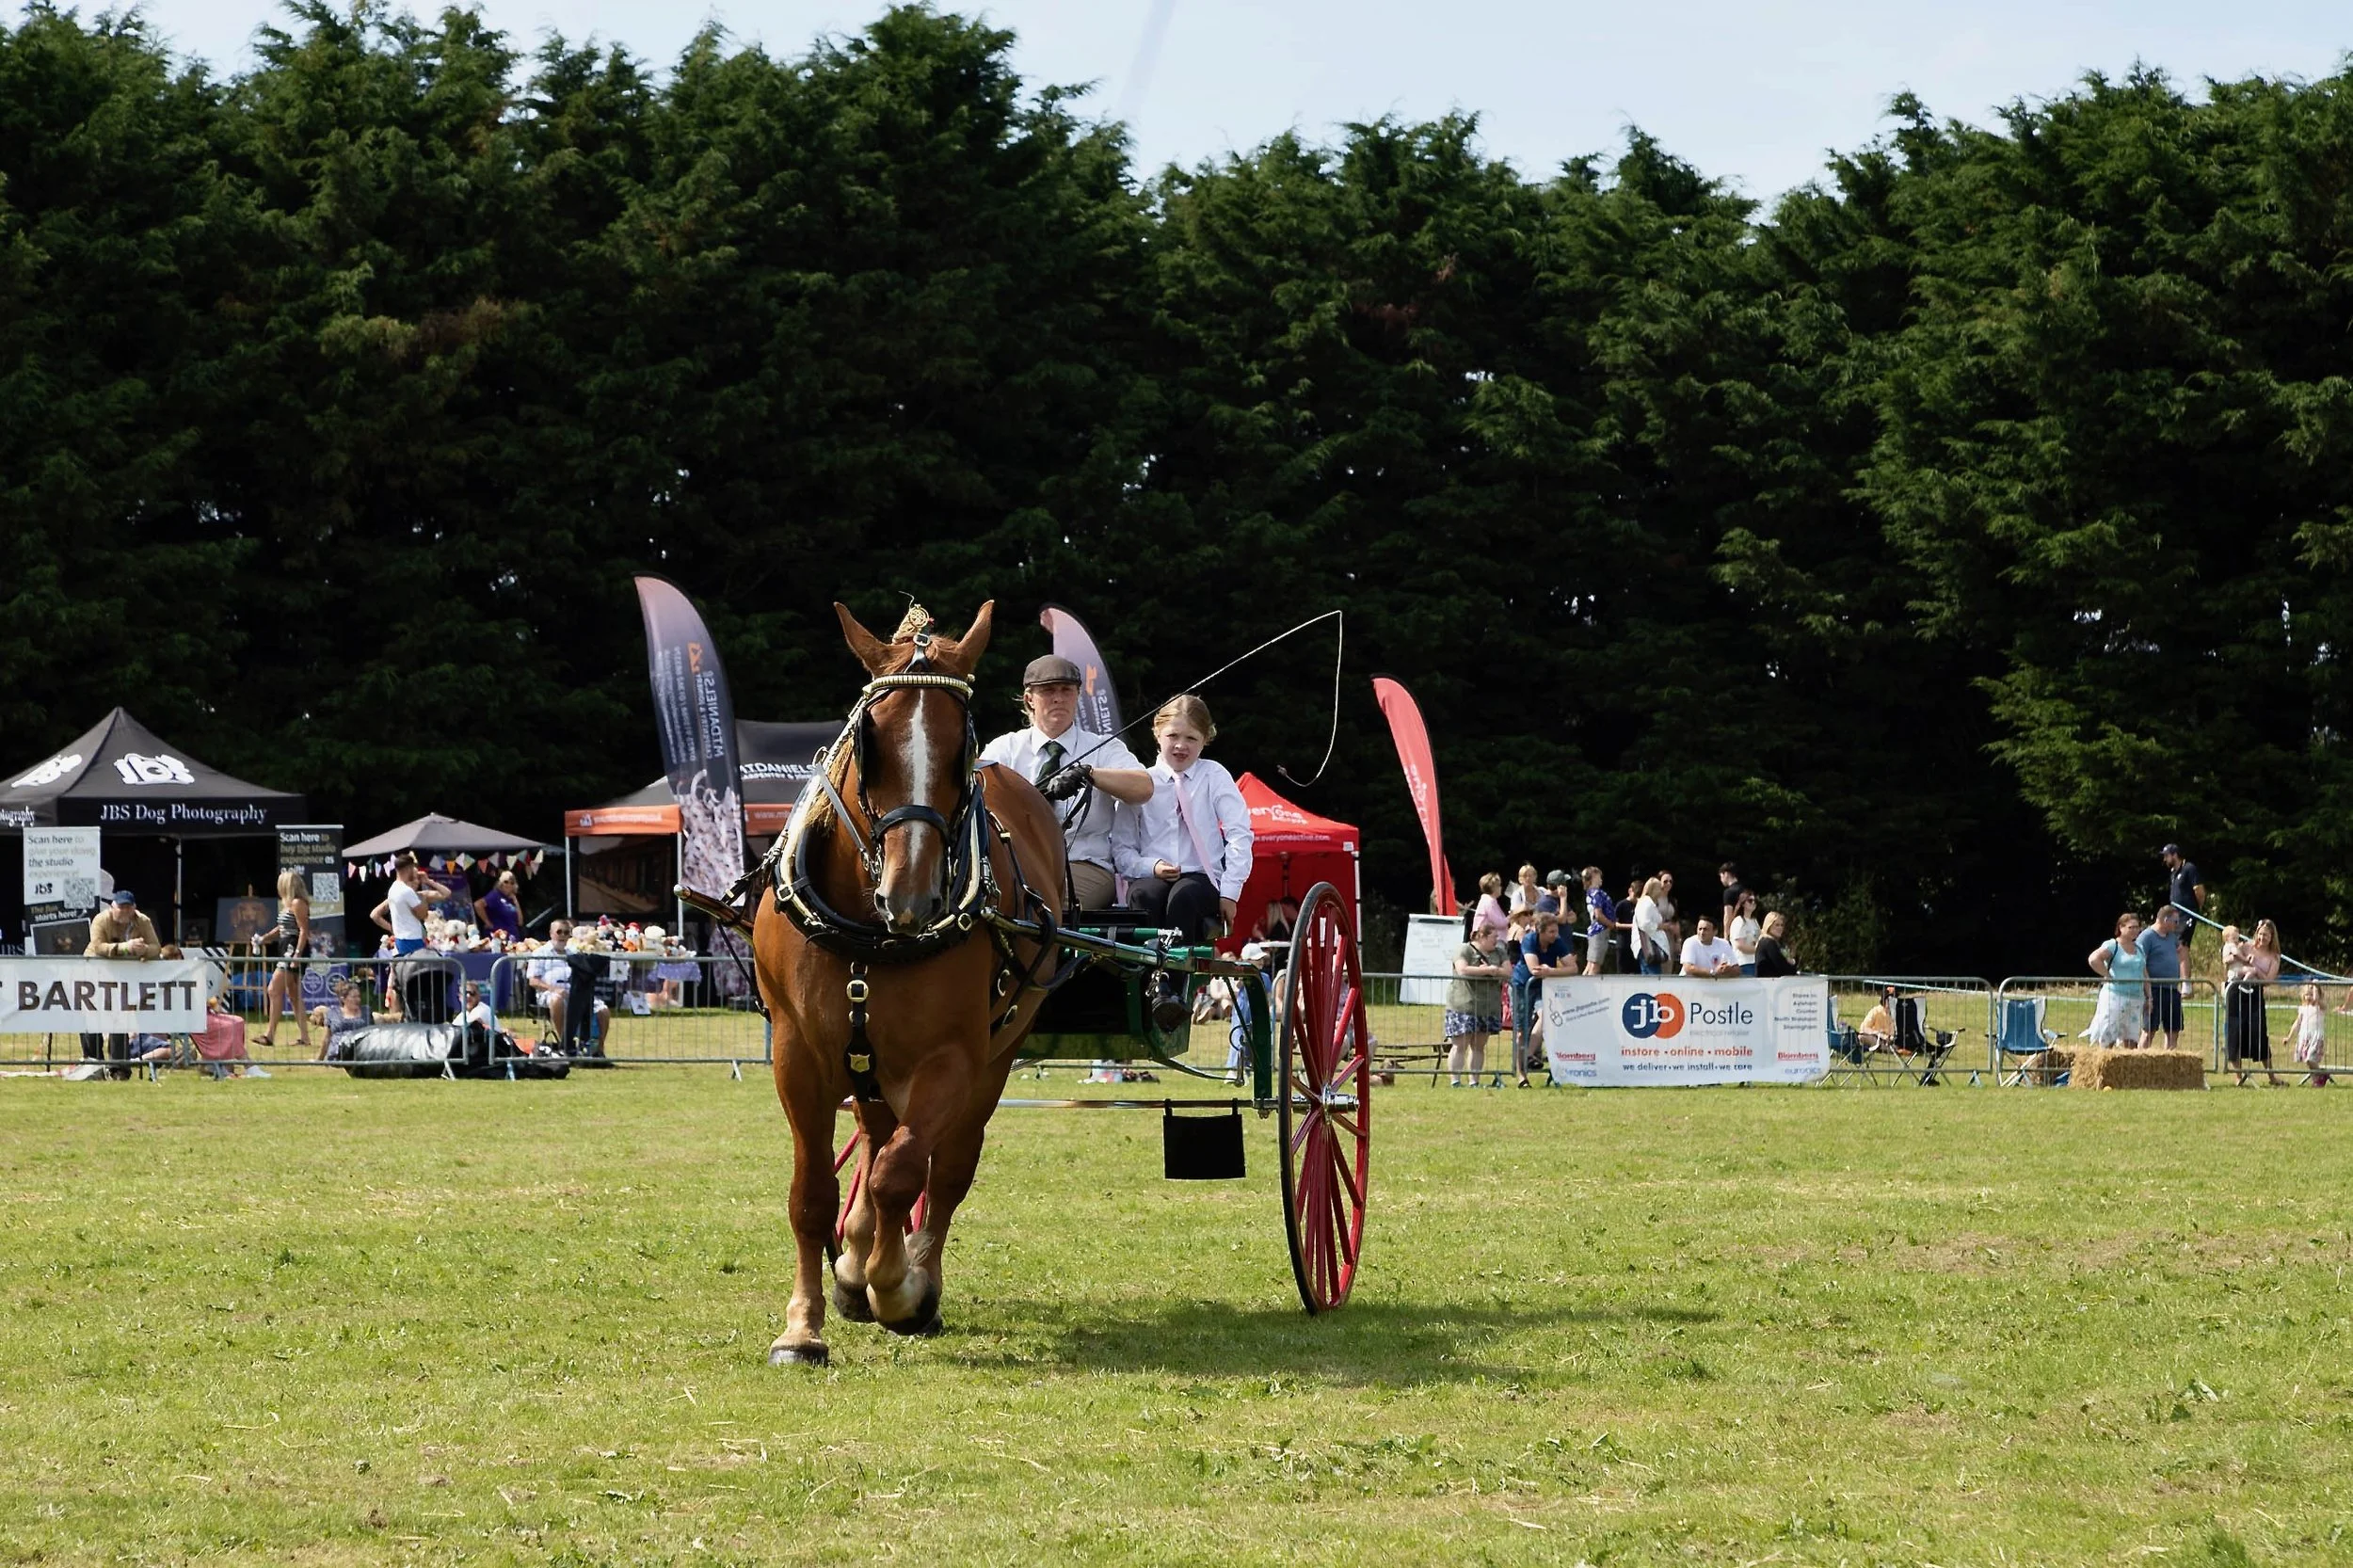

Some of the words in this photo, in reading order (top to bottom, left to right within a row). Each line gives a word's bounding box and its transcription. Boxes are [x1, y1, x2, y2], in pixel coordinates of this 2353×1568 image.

[0, 806, 35, 826] tography
[100, 804, 130, 821] JBS
[136, 804, 166, 824] Dog
[170, 803, 268, 824] Photography
[27, 835, 50, 844] Scan
[52, 835, 72, 844] here
[280, 832, 300, 842] Scan
[300, 832, 320, 842] here
[28, 856, 43, 866] the
[45, 856, 73, 866] studio
[18, 981, 197, 1012] BARTLETT
[1630, 999, 1675, 1030] jb
[1689, 1001, 1753, 1025] Postle
[1622, 1046, 1660, 1056] instore
[1670, 1046, 1705, 1056] online
[1714, 1046, 1753, 1056] mobile
[1637, 1062, 1667, 1071] deliver
[1687, 1062, 1714, 1071] install
